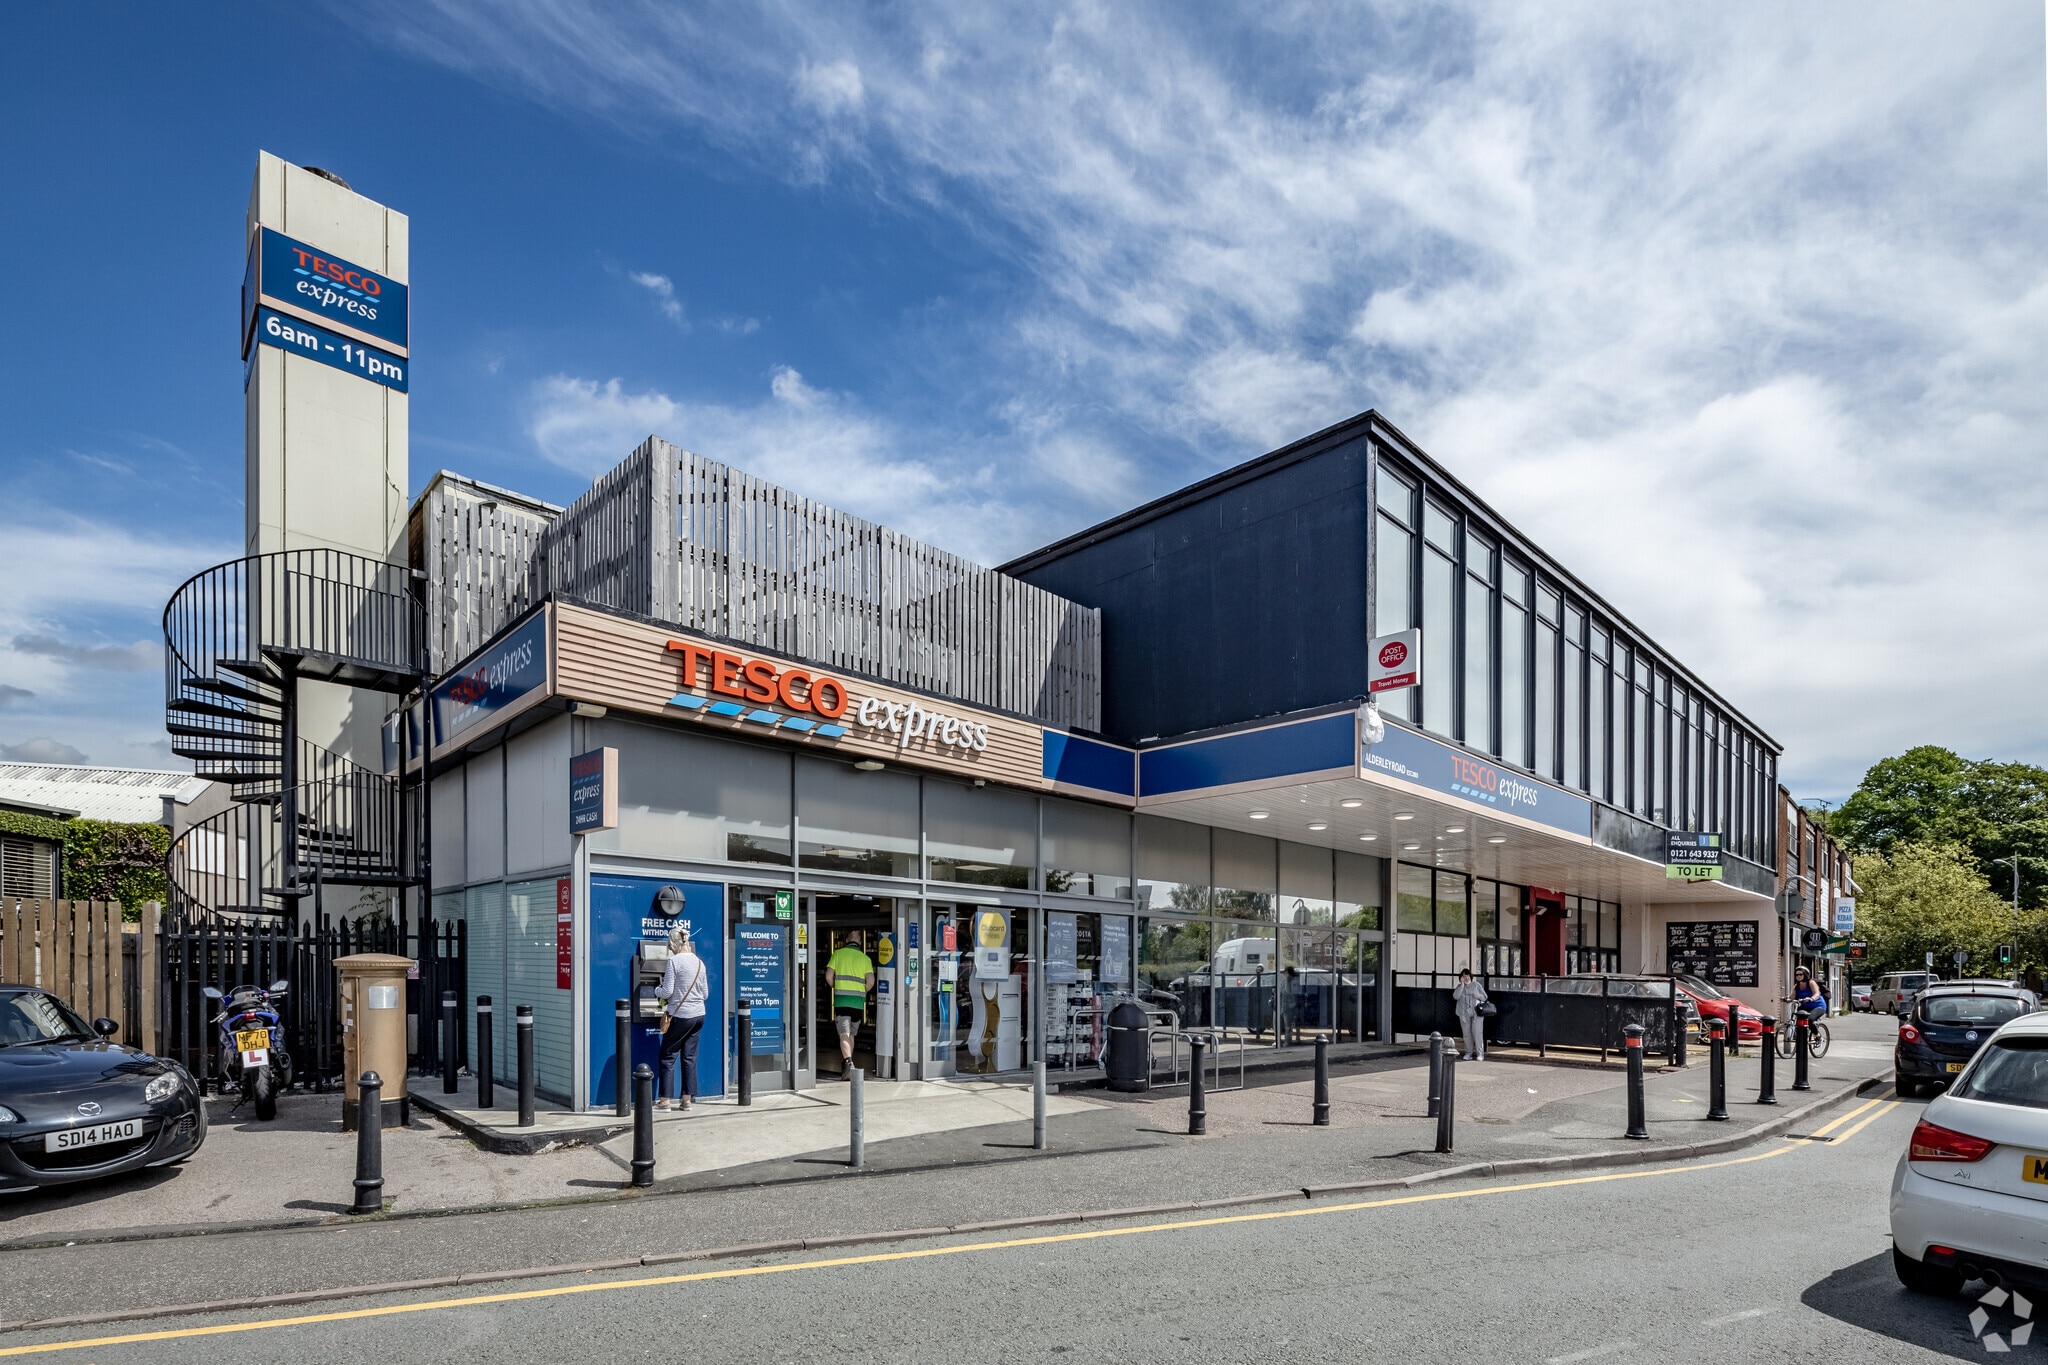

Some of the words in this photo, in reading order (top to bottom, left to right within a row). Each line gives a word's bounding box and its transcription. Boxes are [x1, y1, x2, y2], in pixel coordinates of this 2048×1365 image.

[293, 248, 381, 296] TESCO
[297, 280, 377, 320] express
[266, 316, 318, 351] 6am
[342, 345, 403, 381] 11pm
[1385, 646, 1402, 655] POST
[1381, 653, 1404, 663] OFFICE
[450, 666, 487, 709] TESCO
[490, 639, 532, 692] express
[666, 640, 849, 718] TESCO
[857, 696, 989, 752] express
[573, 757, 601, 777] TESCO
[1365, 753, 1391, 770] ALDERLEY
[1391, 761, 1406, 774] ROAD
[1451, 756, 1497, 792] TESCO
[1500, 778, 1538, 806] express
[574, 784, 600, 805] express
[586, 812, 598, 822] CASH
[1689, 850, 1702, 858] 643
[1677, 867, 1692, 876] TO
[1695, 867, 1712, 876] LET
[641, 918, 665, 928] FREE
[666, 919, 691, 929] CASH
[747, 940, 774, 948] TESCO
[1824, 940, 1847, 951] SUBWAY
[764, 998, 780, 1007] 11pm
[238, 1030, 267, 1042] MF70
[243, 1040, 264, 1050] DHJ
[248, 1051, 262, 1063] L
[58, 1129, 97, 1148] SD14
[102, 1123, 133, 1140] HAO
